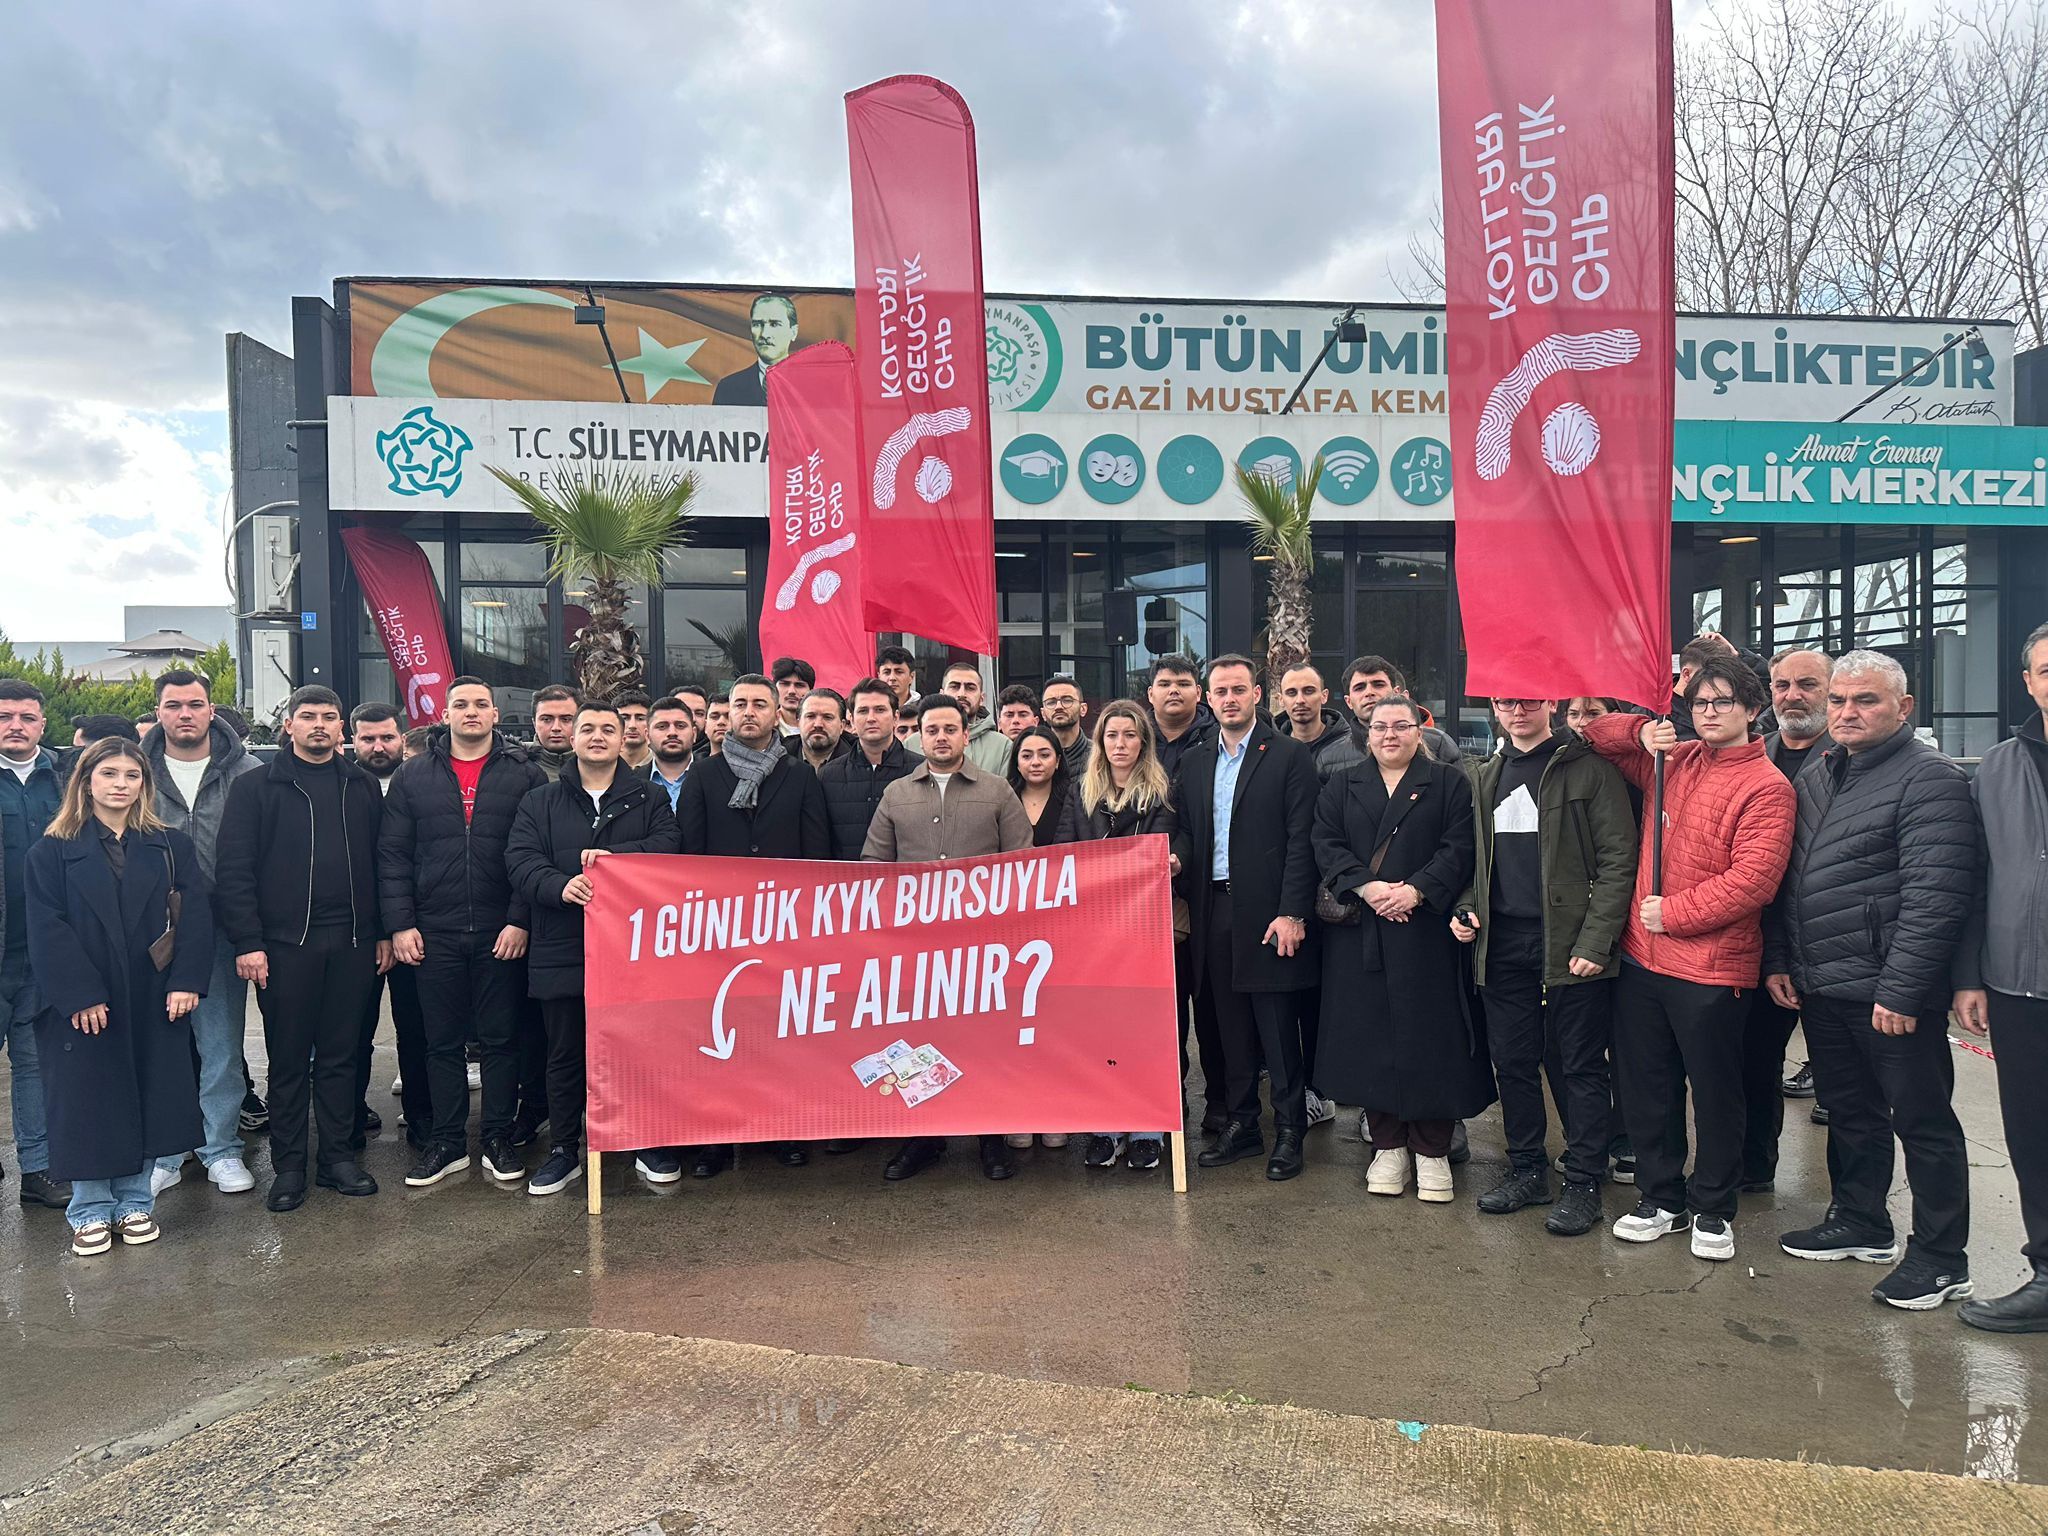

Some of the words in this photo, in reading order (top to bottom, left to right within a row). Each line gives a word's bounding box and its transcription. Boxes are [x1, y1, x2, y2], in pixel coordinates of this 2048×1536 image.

[1085, 312, 1300, 373] BÜTÜN
[1323, 316, 1448, 375] ÜMİ
[1675, 327, 1995, 395] NÇLİKTEDİR
[1085, 378, 1171, 411] GAZİ
[1186, 387, 1359, 413] MUSTAFA
[1371, 389, 1449, 413] KEM
[1672, 451, 1816, 514] NÇLİK
[1830, 457, 2047, 507] MERKEZİ
[1785, 433, 1872, 464] Ahmet
[1868, 435, 1944, 473] Erensoy
[628, 909, 643, 961] 1
[655, 881, 799, 958] GÜNLÜK
[811, 877, 885, 938] KYK
[894, 854, 1078, 926] BURSUYLA
[778, 962, 841, 1039] NE
[851, 939, 1054, 1046] ALINIR?
